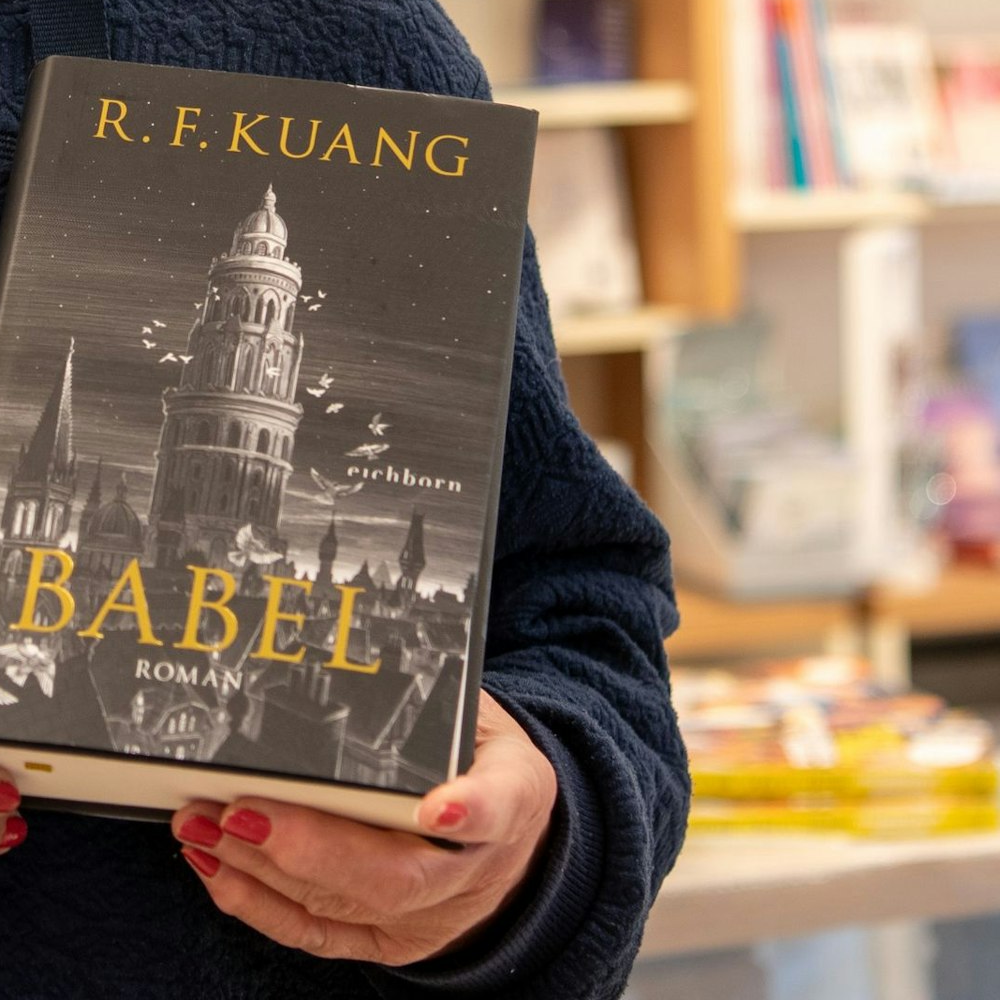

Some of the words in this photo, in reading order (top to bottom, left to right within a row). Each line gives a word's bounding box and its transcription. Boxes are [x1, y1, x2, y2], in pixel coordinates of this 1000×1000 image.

[93, 98, 151, 143] R.
[169, 106, 208, 150] F.
[227, 112, 469, 177] KUANG
[347, 465, 462, 493] eichborn
[10, 547, 382, 674] BABEL
[135, 658, 243, 691] ROMAN
